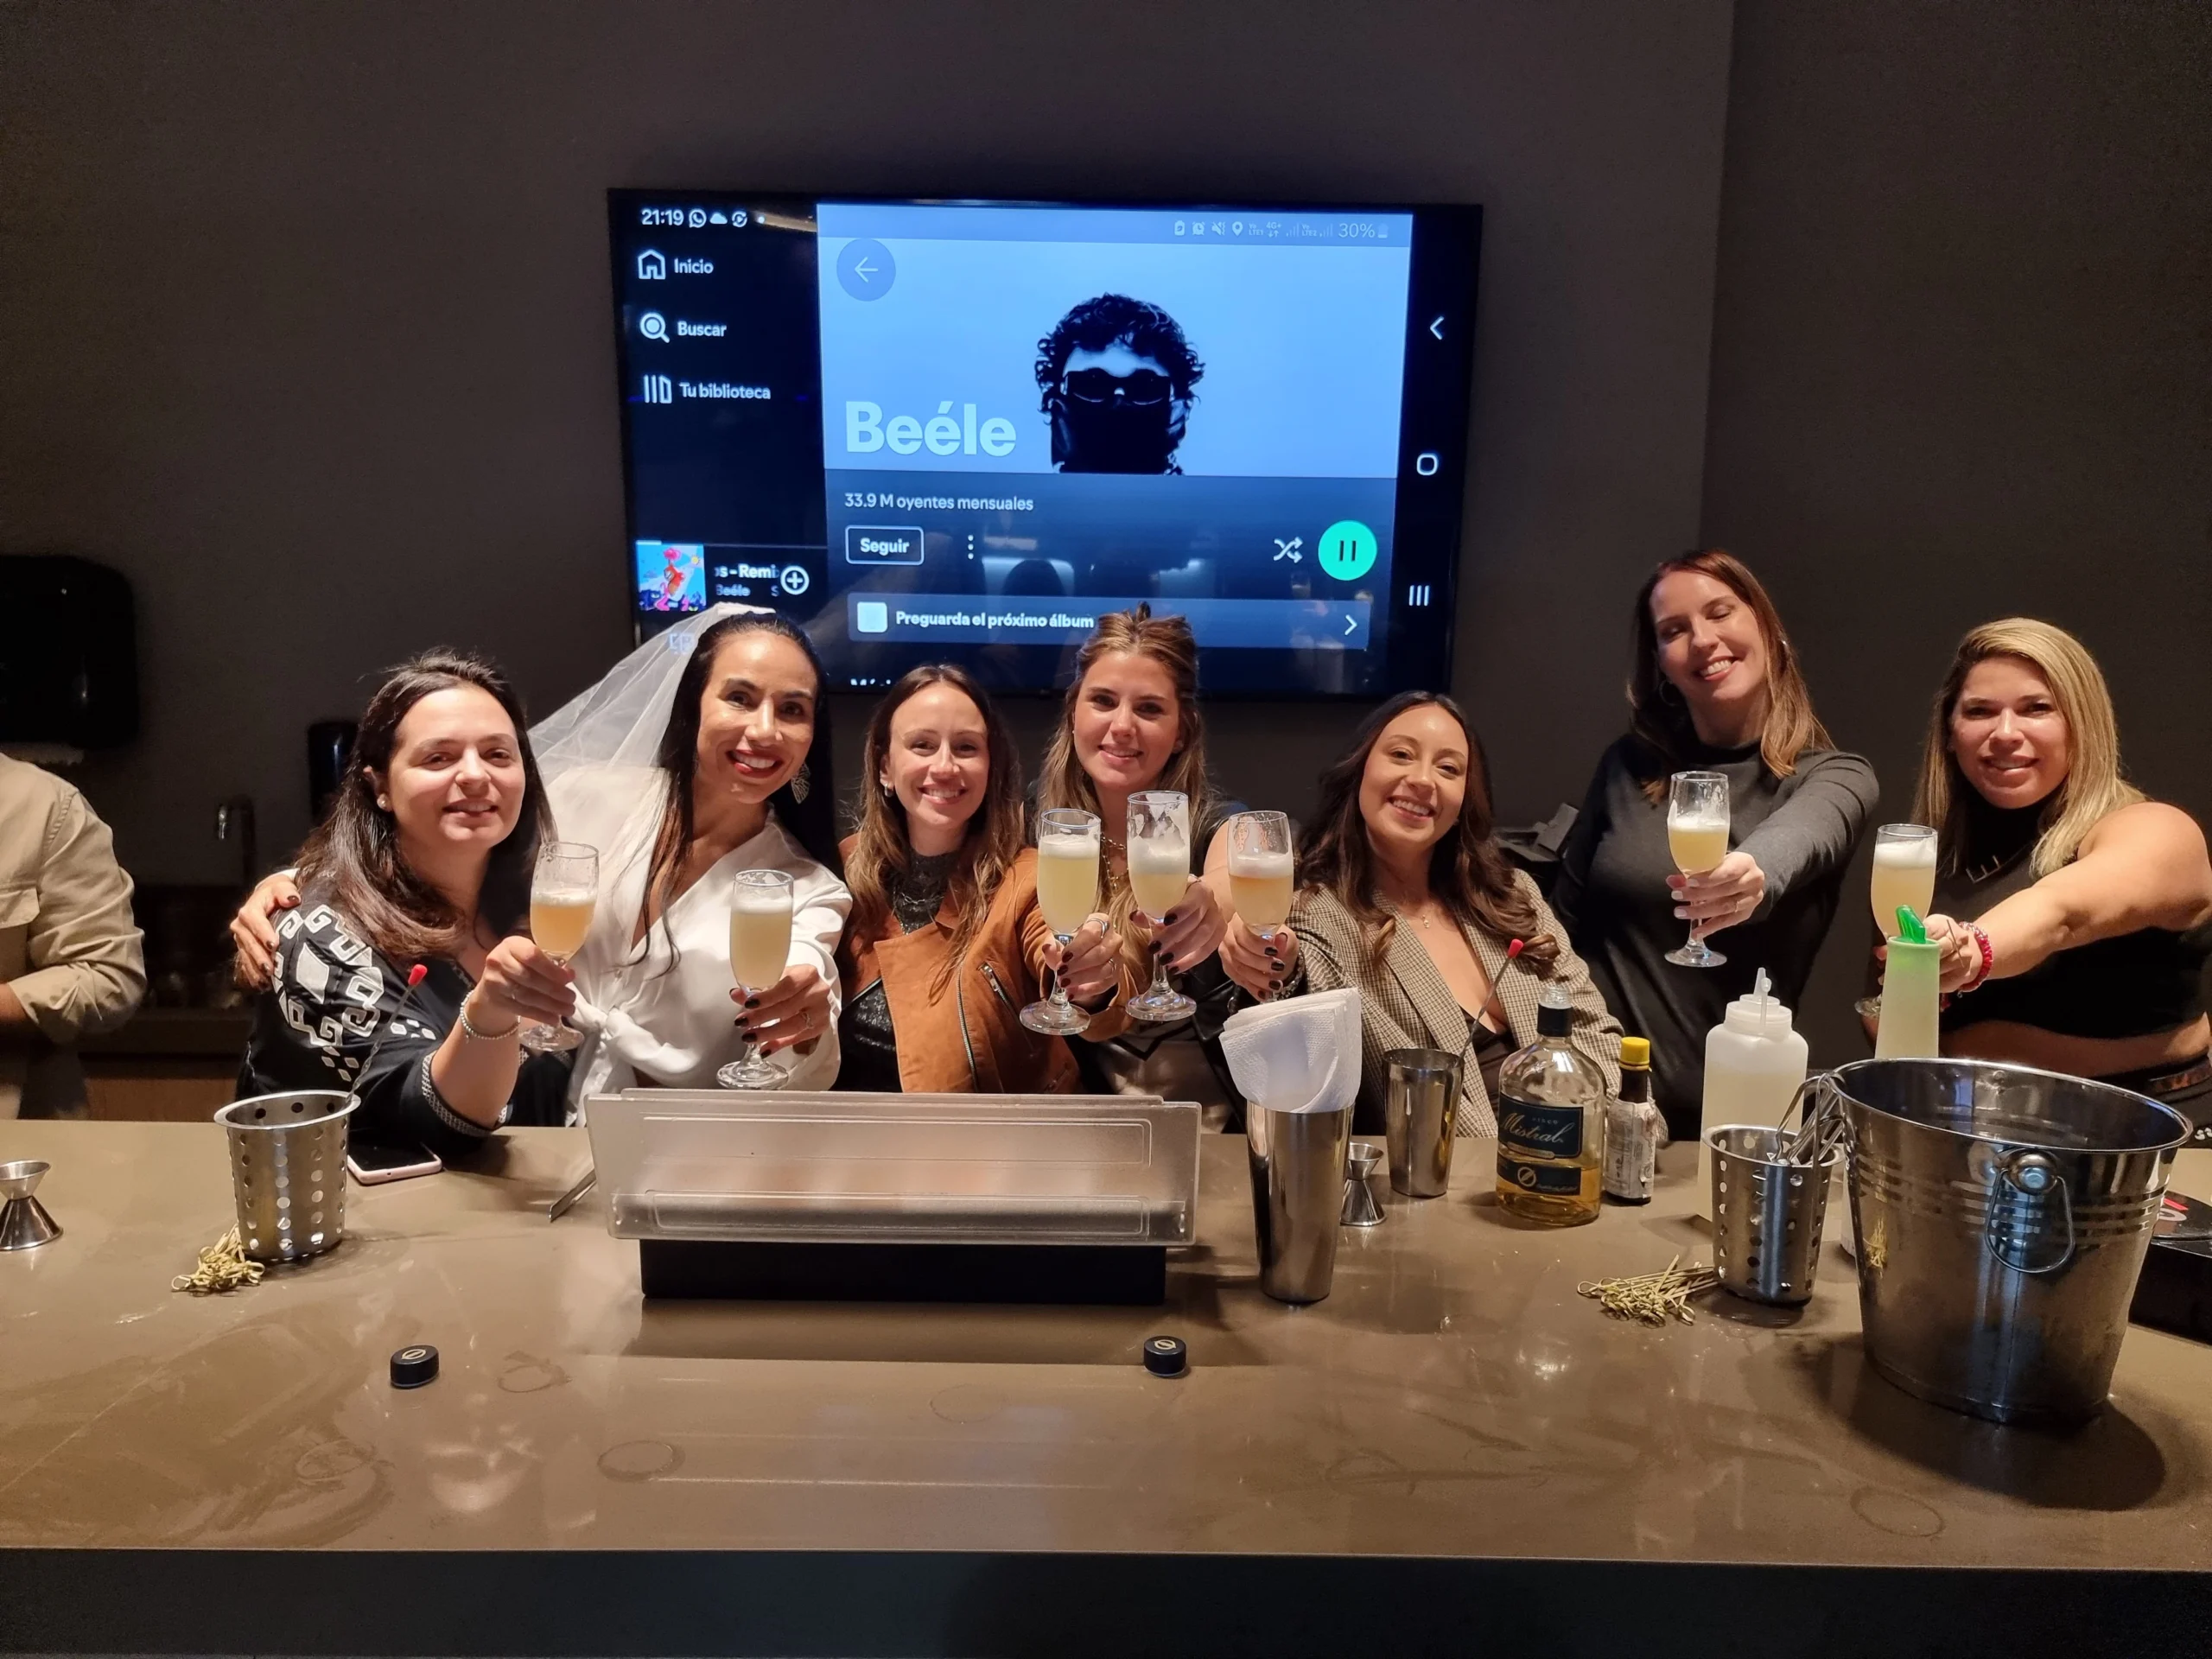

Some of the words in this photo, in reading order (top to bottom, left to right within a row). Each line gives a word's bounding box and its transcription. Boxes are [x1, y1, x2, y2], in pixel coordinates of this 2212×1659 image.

[641, 209, 683, 226] 21:19
[1338, 223, 1376, 238] 30%
[674, 258, 714, 274] Inicio
[677, 321, 727, 337] Buscar
[679, 382, 696, 397] Tu
[699, 383, 771, 399] biblioteca
[845, 400, 1017, 457] Beéle
[844, 493, 877, 508] 33.9
[880, 494, 894, 508] M
[897, 495, 955, 512] oyentes
[957, 495, 1033, 512] mensuales
[860, 537, 910, 556] Seguir
[895, 611, 970, 628] Preguarda
[972, 612, 986, 626] el
[988, 612, 1048, 629] próximo
[1049, 612, 1094, 628] álbum
[1501, 1112, 1575, 1143] Mistral
